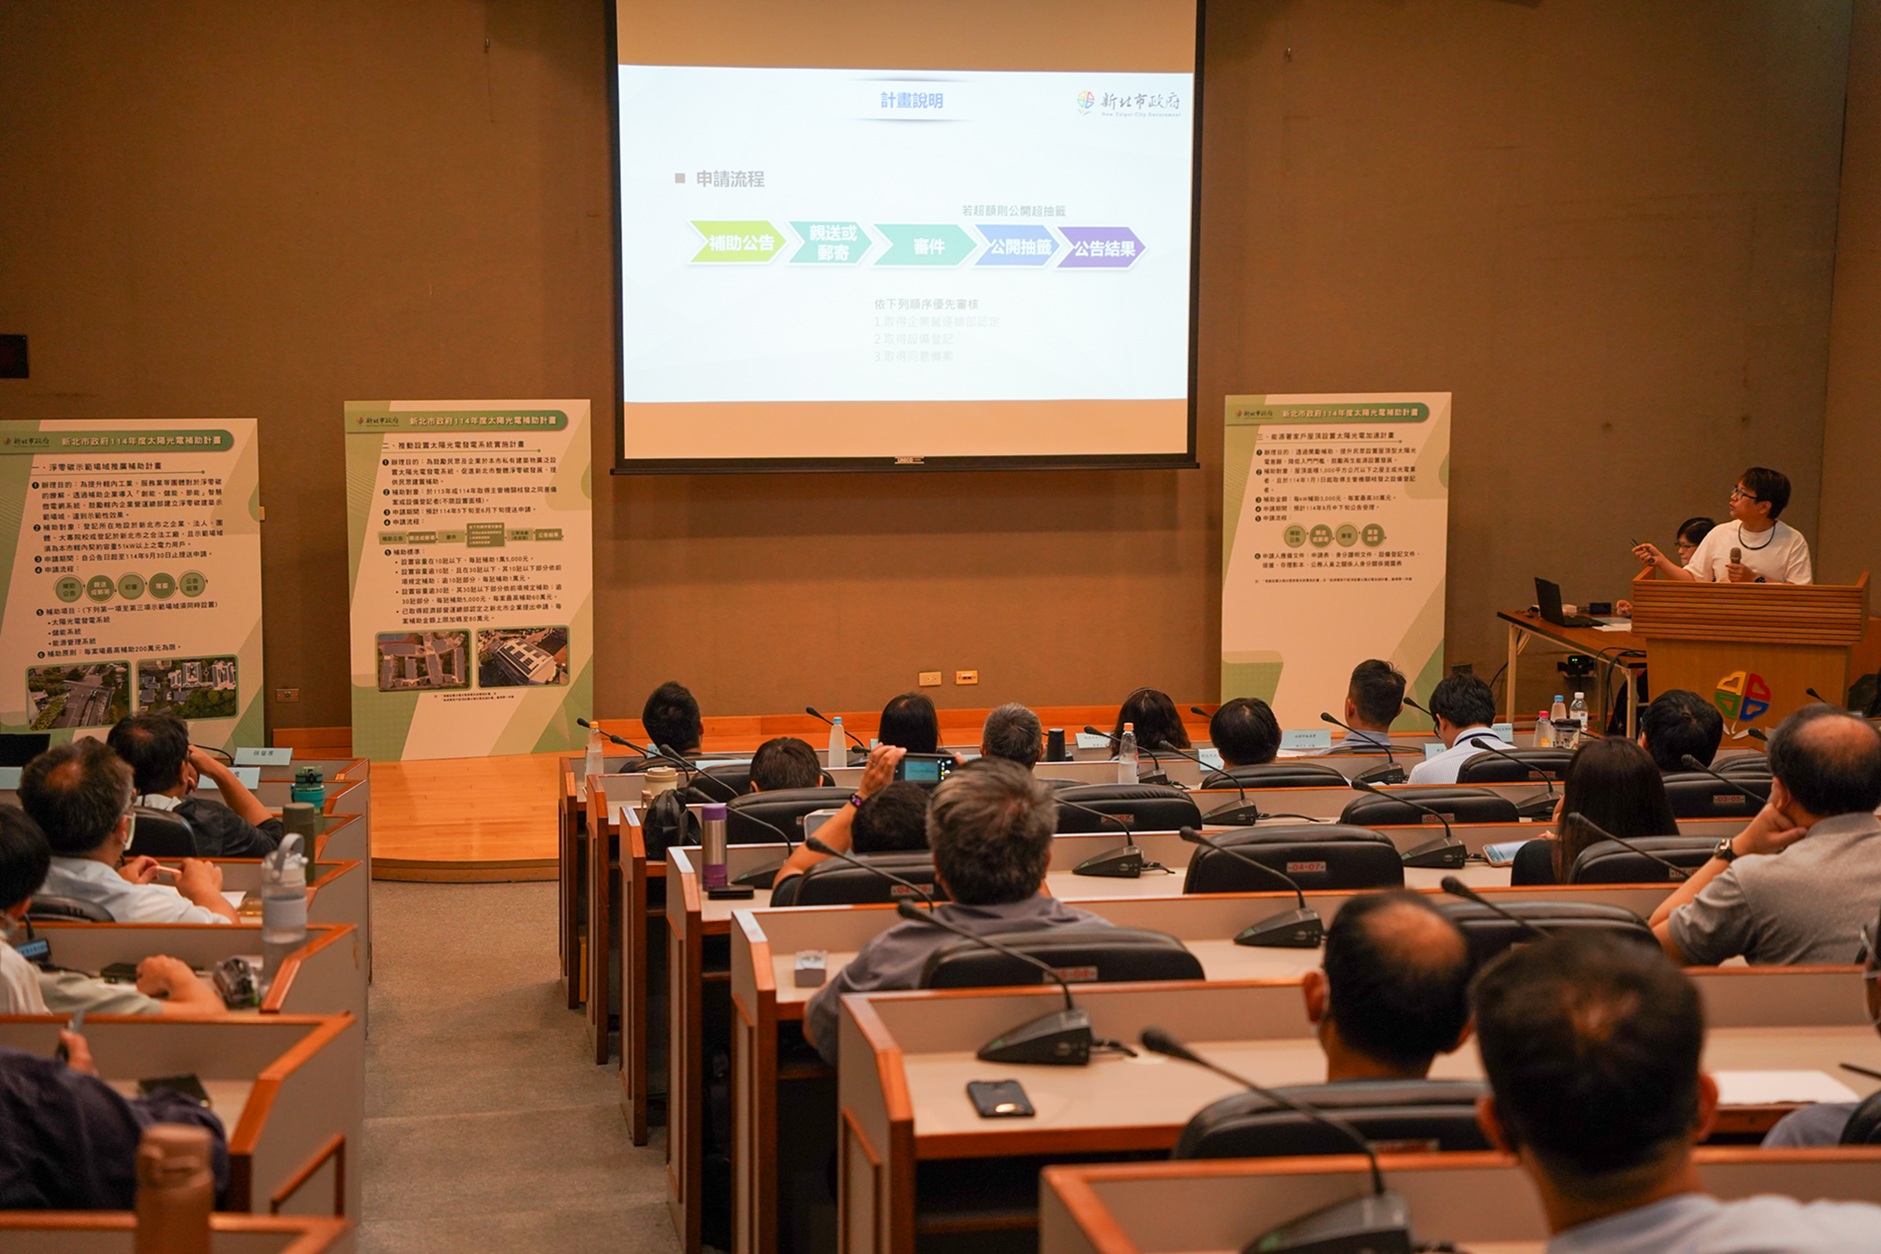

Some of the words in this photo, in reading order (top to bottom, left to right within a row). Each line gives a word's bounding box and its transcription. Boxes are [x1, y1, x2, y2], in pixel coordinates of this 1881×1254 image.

[881, 91, 944, 110] 計畫說明
[1101, 92, 1180, 110] 新北市政府
[697, 170, 765, 188] 申請流程
[809, 224, 857, 241] 親送或
[709, 234, 775, 252] 補助公告
[914, 238, 945, 255] 審件
[991, 238, 1052, 256] 公開抽籤
[1075, 240, 1136, 257] 公告結果
[817, 244, 850, 261] 郵寄
[875, 298, 979, 310] 依下列順序優先審核
[409, 416, 557, 426] 新北市政府114年度太陽光電補助計畫
[1282, 408, 1419, 418] 新北市政府114年度太陽光電補助計畫
[61, 435, 222, 447] 新北市政府114年度太陽光電補助計畫
